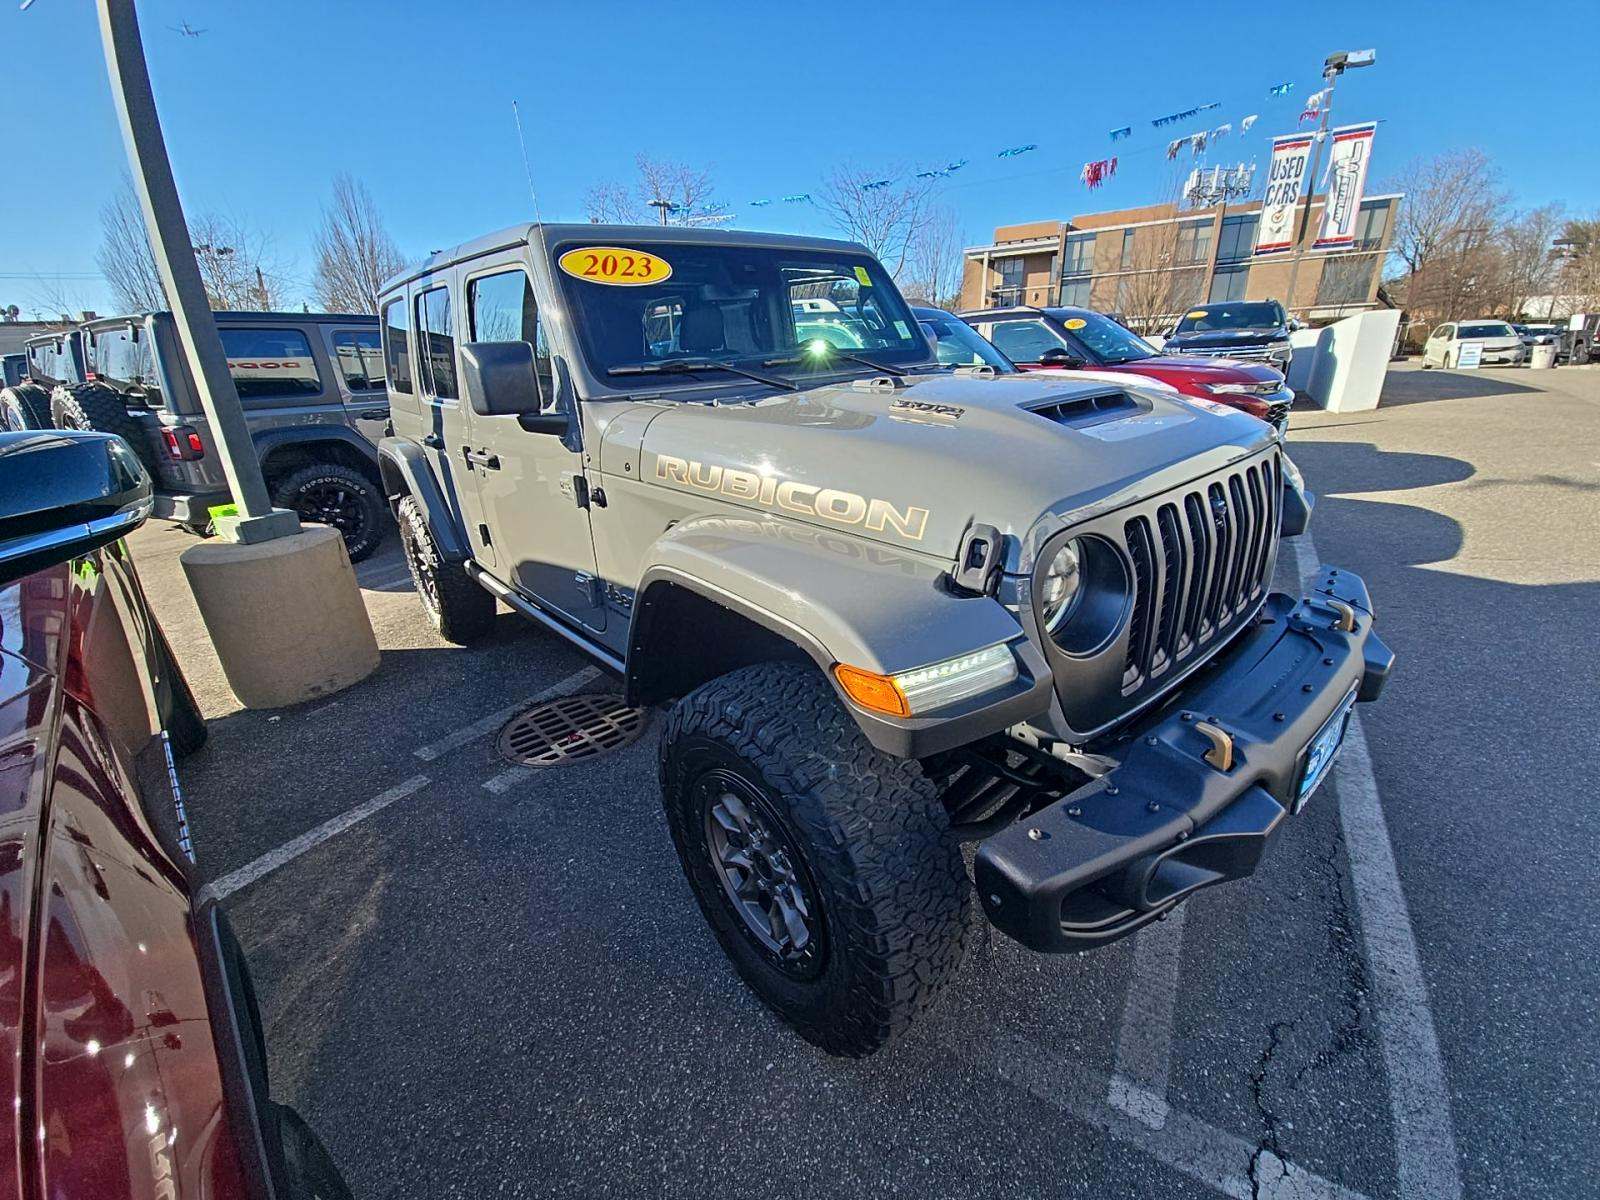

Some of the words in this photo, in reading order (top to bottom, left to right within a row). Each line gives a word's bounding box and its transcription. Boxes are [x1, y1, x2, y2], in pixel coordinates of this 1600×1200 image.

[1271, 155, 1305, 181] USED
[1265, 180, 1300, 207] CARS
[582, 254, 653, 278] 2023
[656, 454, 929, 541] RUBICON
